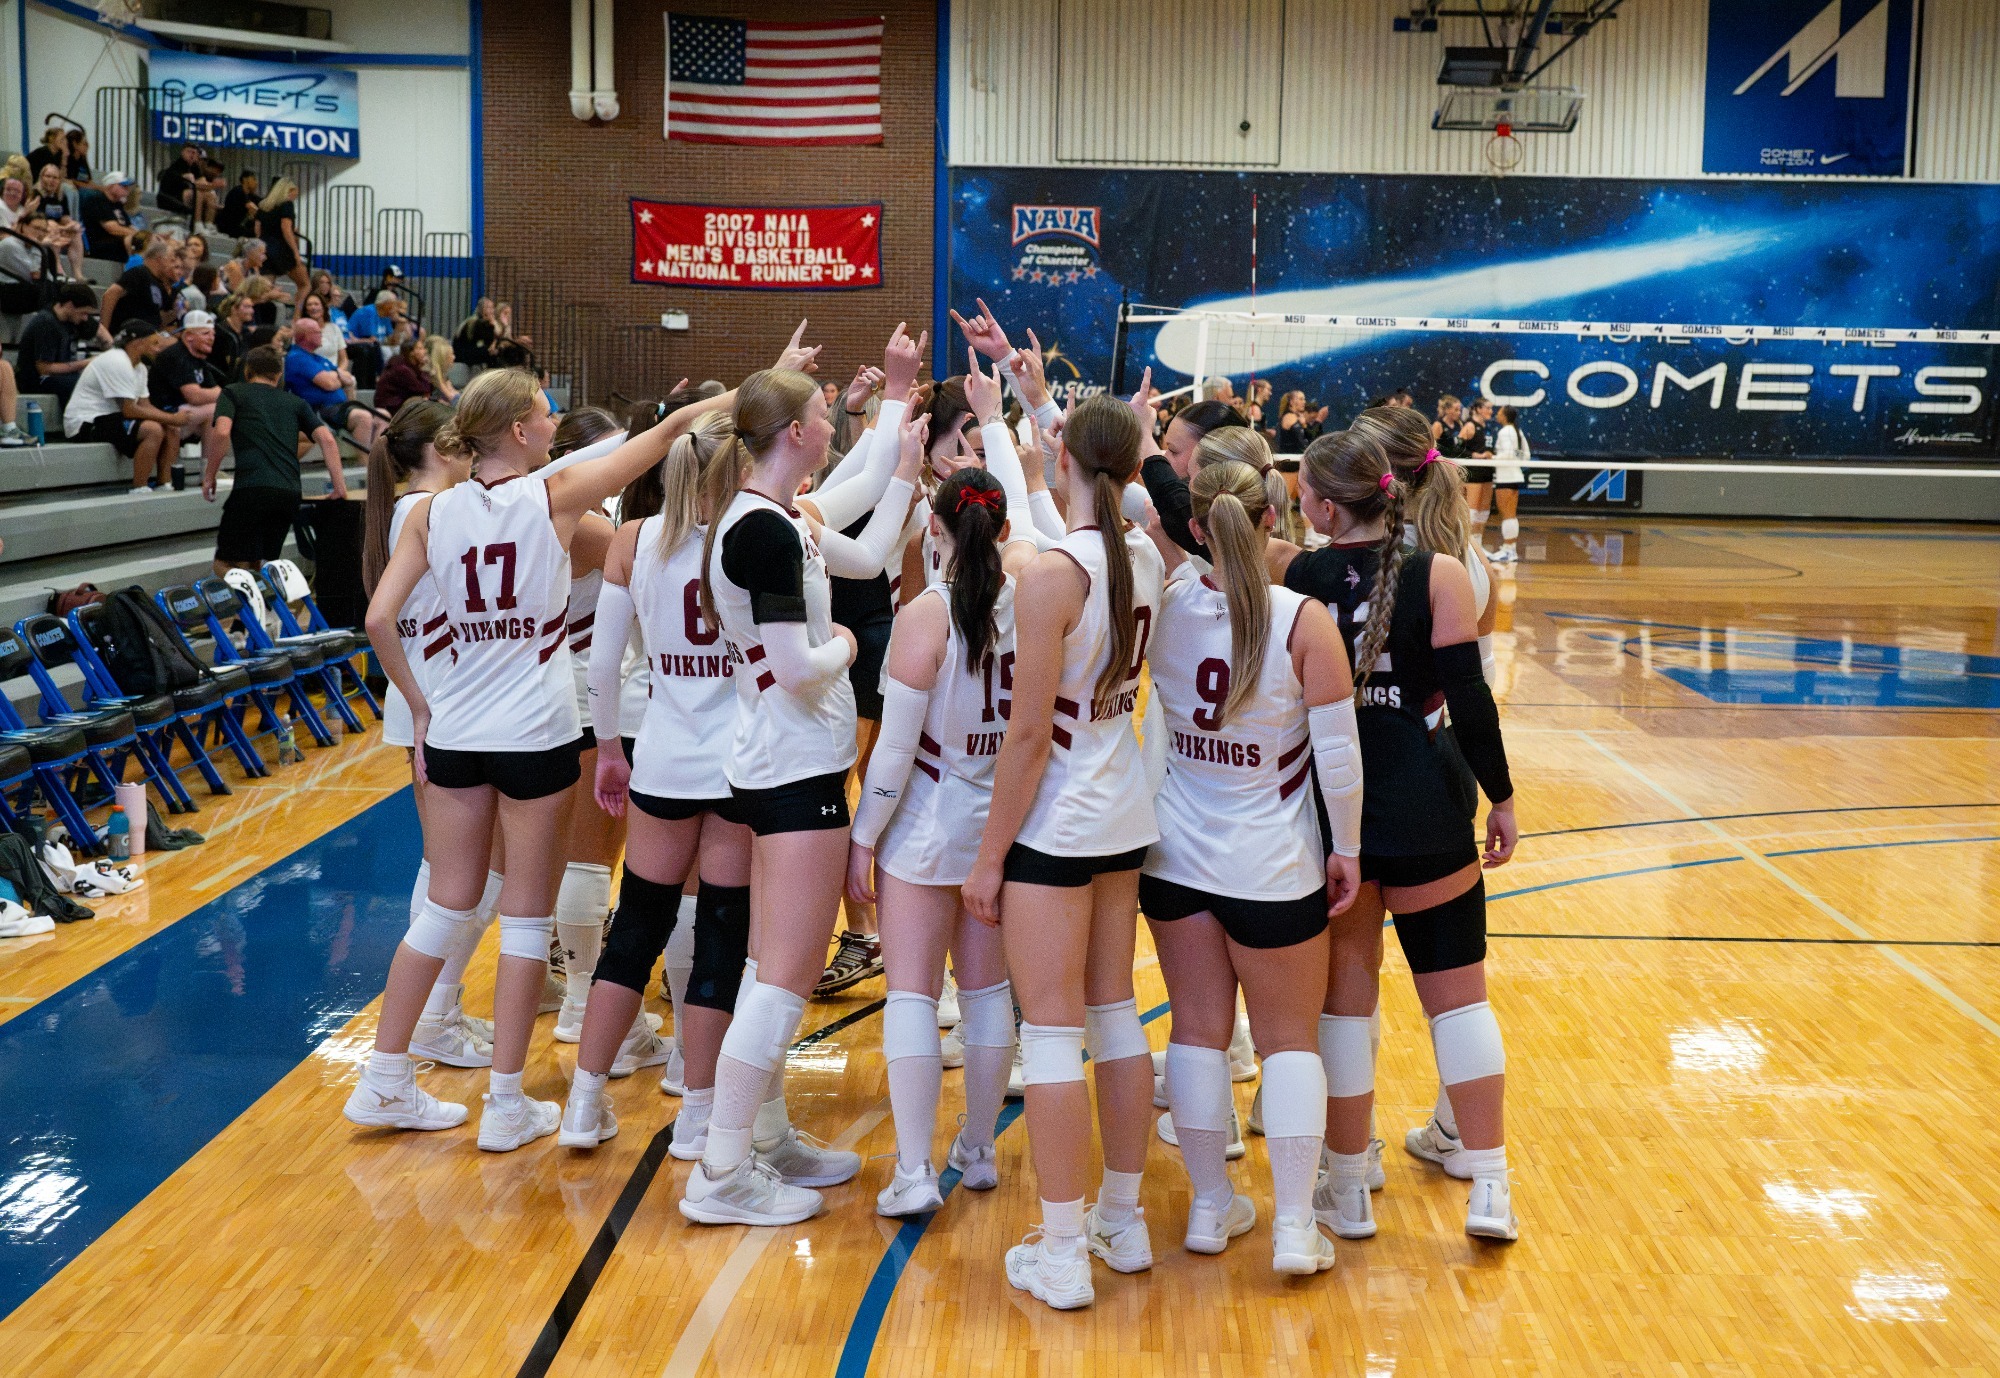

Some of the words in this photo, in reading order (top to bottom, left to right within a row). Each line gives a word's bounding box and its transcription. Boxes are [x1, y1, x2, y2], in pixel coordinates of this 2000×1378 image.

[162, 78, 340, 113] COMETS
[163, 115, 351, 154] DEDICATION
[1760, 148, 1815, 158] COMET
[704, 213, 755, 231] 2007
[765, 214, 810, 232] NAIA
[1013, 207, 1098, 243] NAIA
[705, 230, 791, 248] DIVISION
[797, 231, 811, 248] II
[1025, 243, 1087, 256] Champions
[666, 244, 723, 262] MEN'S
[734, 247, 848, 265] BASKETBALL
[1021, 254, 1036, 266] of
[657, 260, 741, 281] NATIONAL
[751, 264, 856, 282] RUNNER-UP
[1284, 315, 1306, 324] MSU
[1355, 317, 1397, 327] COMETS
[1447, 319, 1468, 329] MSU
[1518, 321, 1560, 331] COMETS
[1610, 323, 1631, 333] MSU
[1681, 325, 1723, 335] COMETS
[1773, 327, 1795, 337] MSU
[1844, 329, 1886, 338] COMETS
[1936, 331, 1958, 340] MSU
[1479, 358, 1988, 414] COMETS
[461, 542, 517, 613] 17
[460, 617, 536, 643] VIKINGS
[660, 653, 734, 678] VIKING
[1192, 657, 1231, 732] 9
[1174, 731, 1261, 768] VIKINGS
